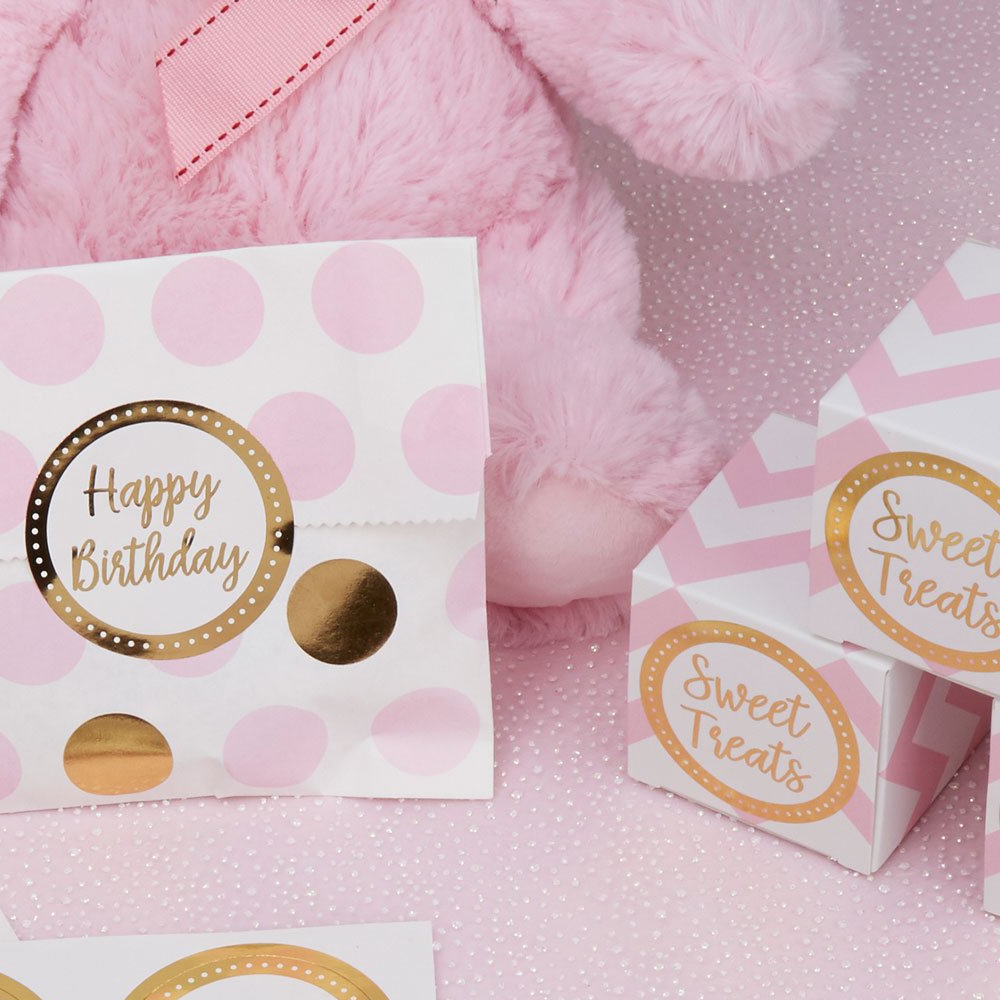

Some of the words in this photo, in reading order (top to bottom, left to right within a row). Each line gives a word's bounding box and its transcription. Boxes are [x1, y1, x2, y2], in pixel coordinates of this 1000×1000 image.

[83, 464, 221, 529] Happy
[871, 489, 1000, 578] Sweet
[71, 528, 249, 592] Birthday
[868, 546, 1000, 639] Treats
[682, 653, 811, 739] Sweet
[680, 703, 812, 794] Treats
